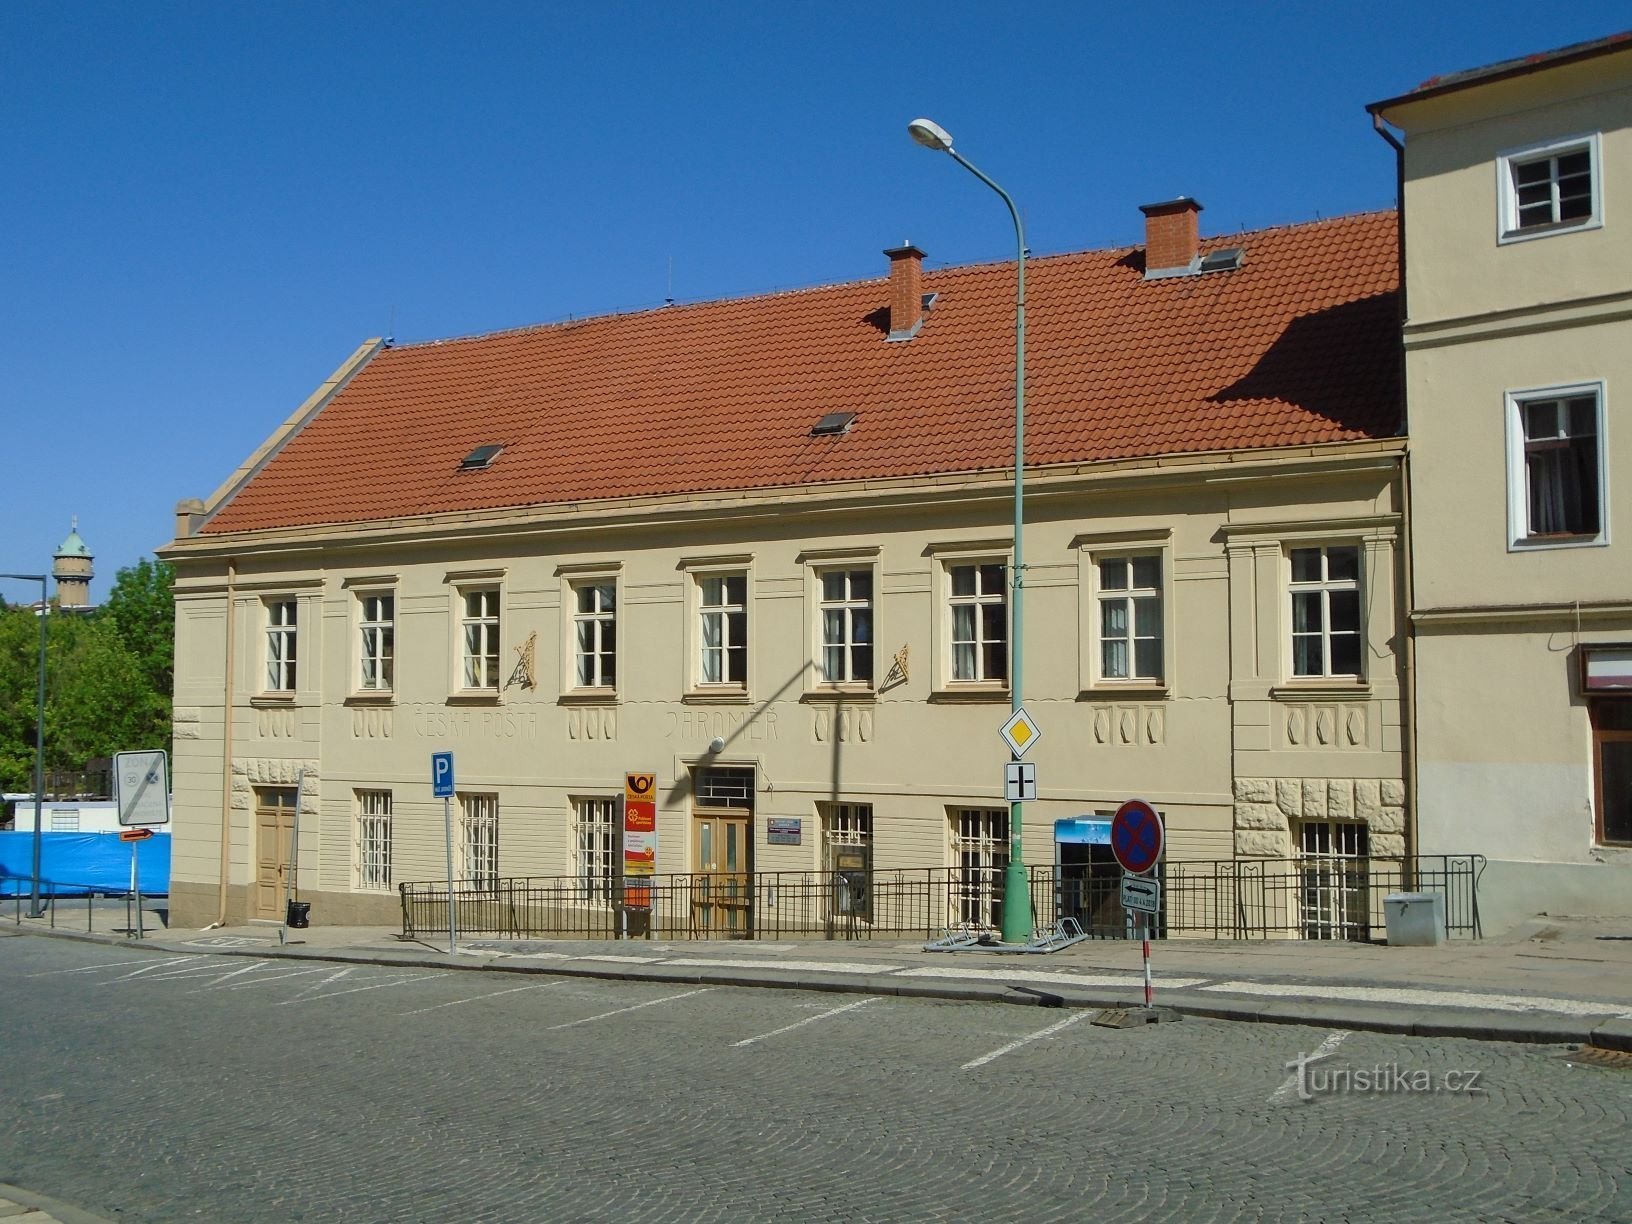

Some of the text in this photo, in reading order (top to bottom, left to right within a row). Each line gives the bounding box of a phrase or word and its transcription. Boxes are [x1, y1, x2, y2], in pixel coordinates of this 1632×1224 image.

[414, 708, 537, 738] ČESKÁ POŠTA
[665, 707, 778, 740] JAROMĚŘ
[436, 758, 449, 783] P
